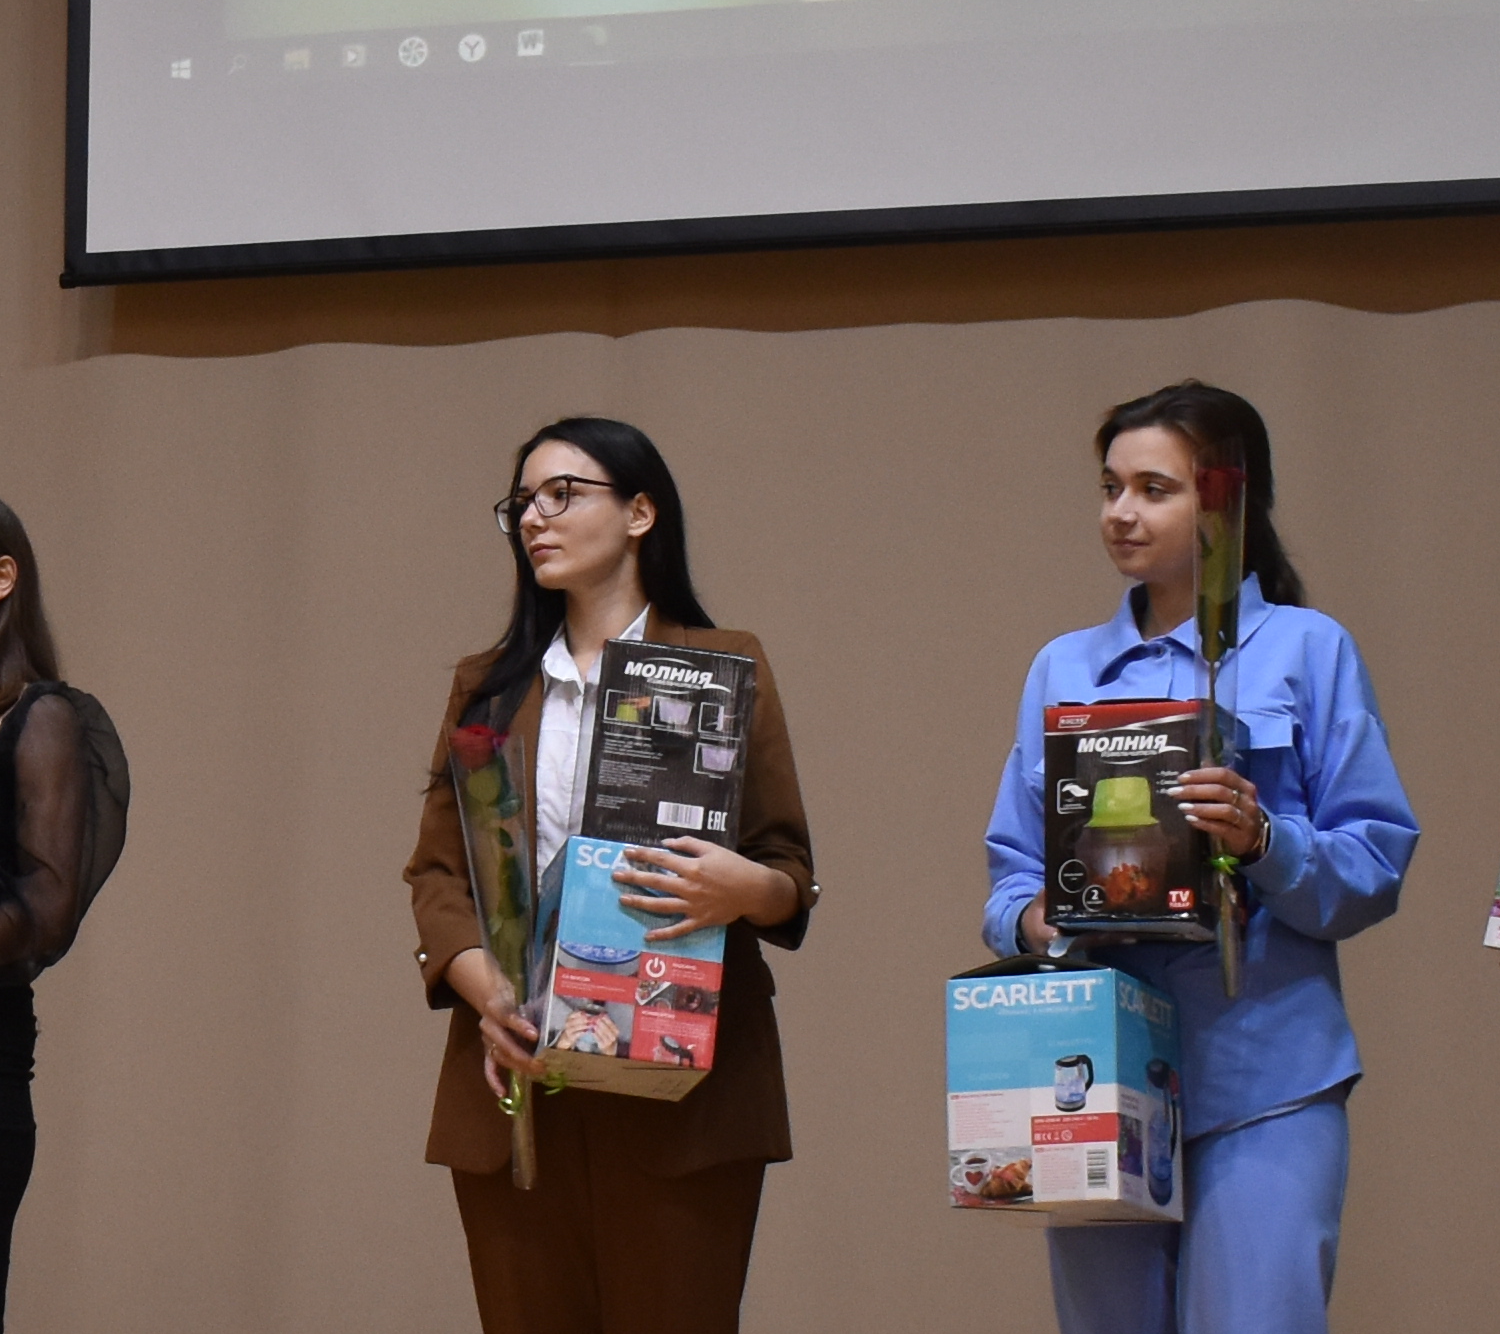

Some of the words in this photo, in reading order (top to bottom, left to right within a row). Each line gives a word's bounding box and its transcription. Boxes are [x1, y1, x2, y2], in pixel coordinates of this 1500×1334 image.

[624, 661, 716, 688] МОЛНИЯ
[1077, 734, 1172, 754] МОЛНИЯ
[1090, 889, 1099, 901] 2
[1168, 890, 1190, 902] TV
[953, 978, 1097, 1012] SCARLETT
[1118, 980, 1177, 1028] SCARLETT
